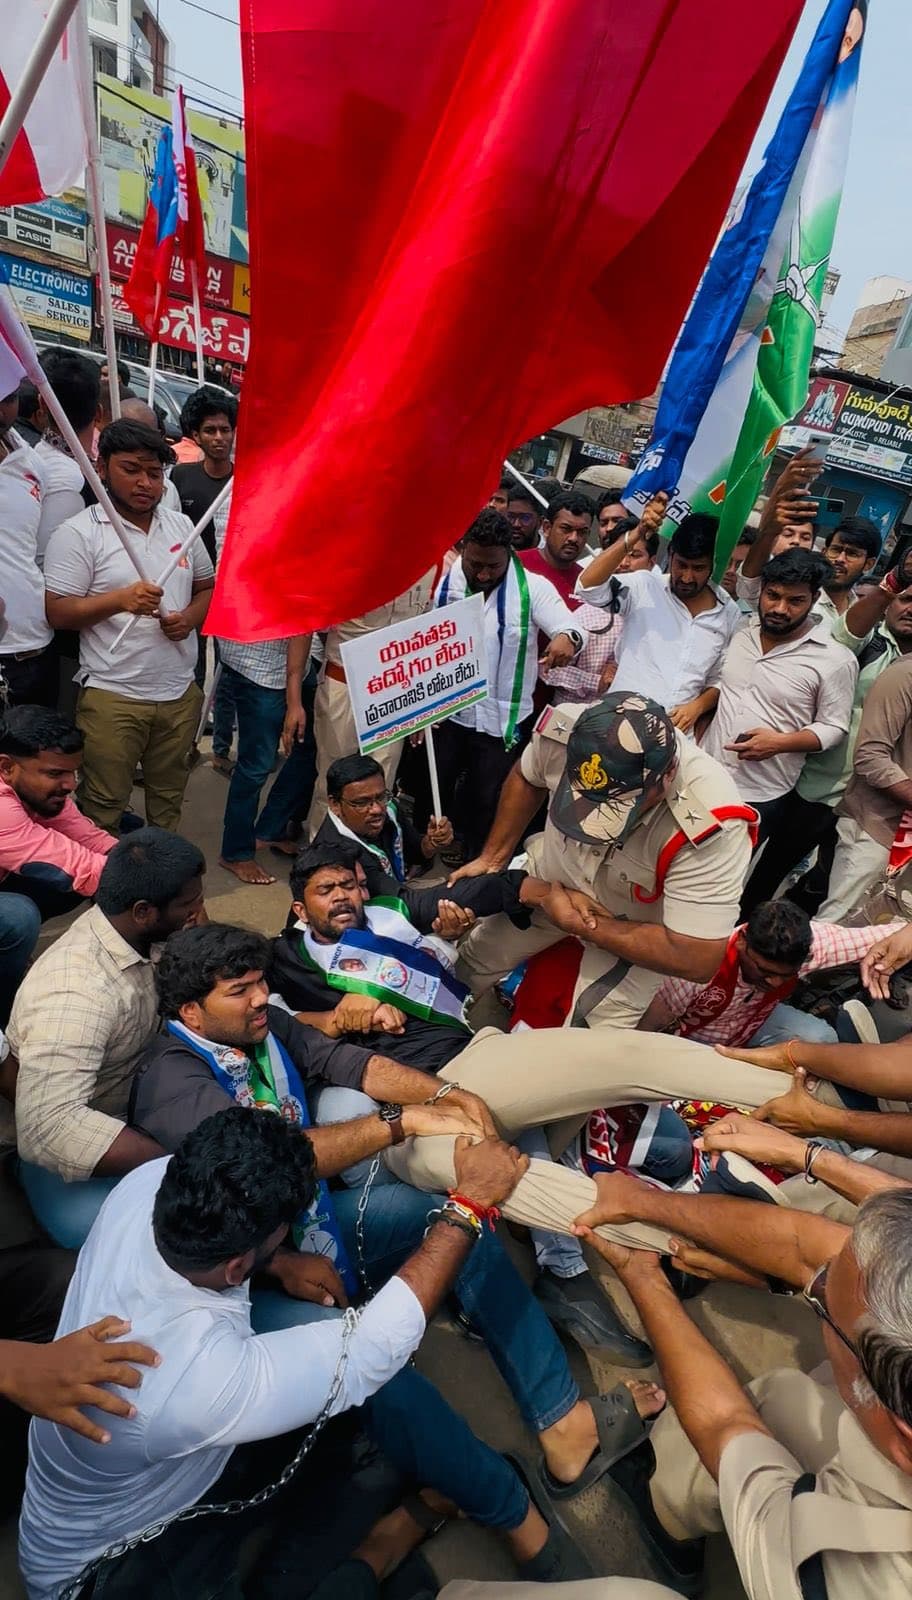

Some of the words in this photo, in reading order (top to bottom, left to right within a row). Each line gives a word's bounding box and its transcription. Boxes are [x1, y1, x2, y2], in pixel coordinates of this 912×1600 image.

[17, 229, 51, 245] CASIO
[11, 263, 89, 297] ELECTRONICS
[46, 309, 90, 328] SERVICE
[48, 297, 80, 314] SALES
[840, 411, 893, 435] GUNUPUDI
[379, 619, 457, 664] యువతకు
[366, 657, 433, 695] ఉద్యోగం
[364, 682, 426, 727] ప్రచారానికి
[427, 673, 454, 697] లోటు
